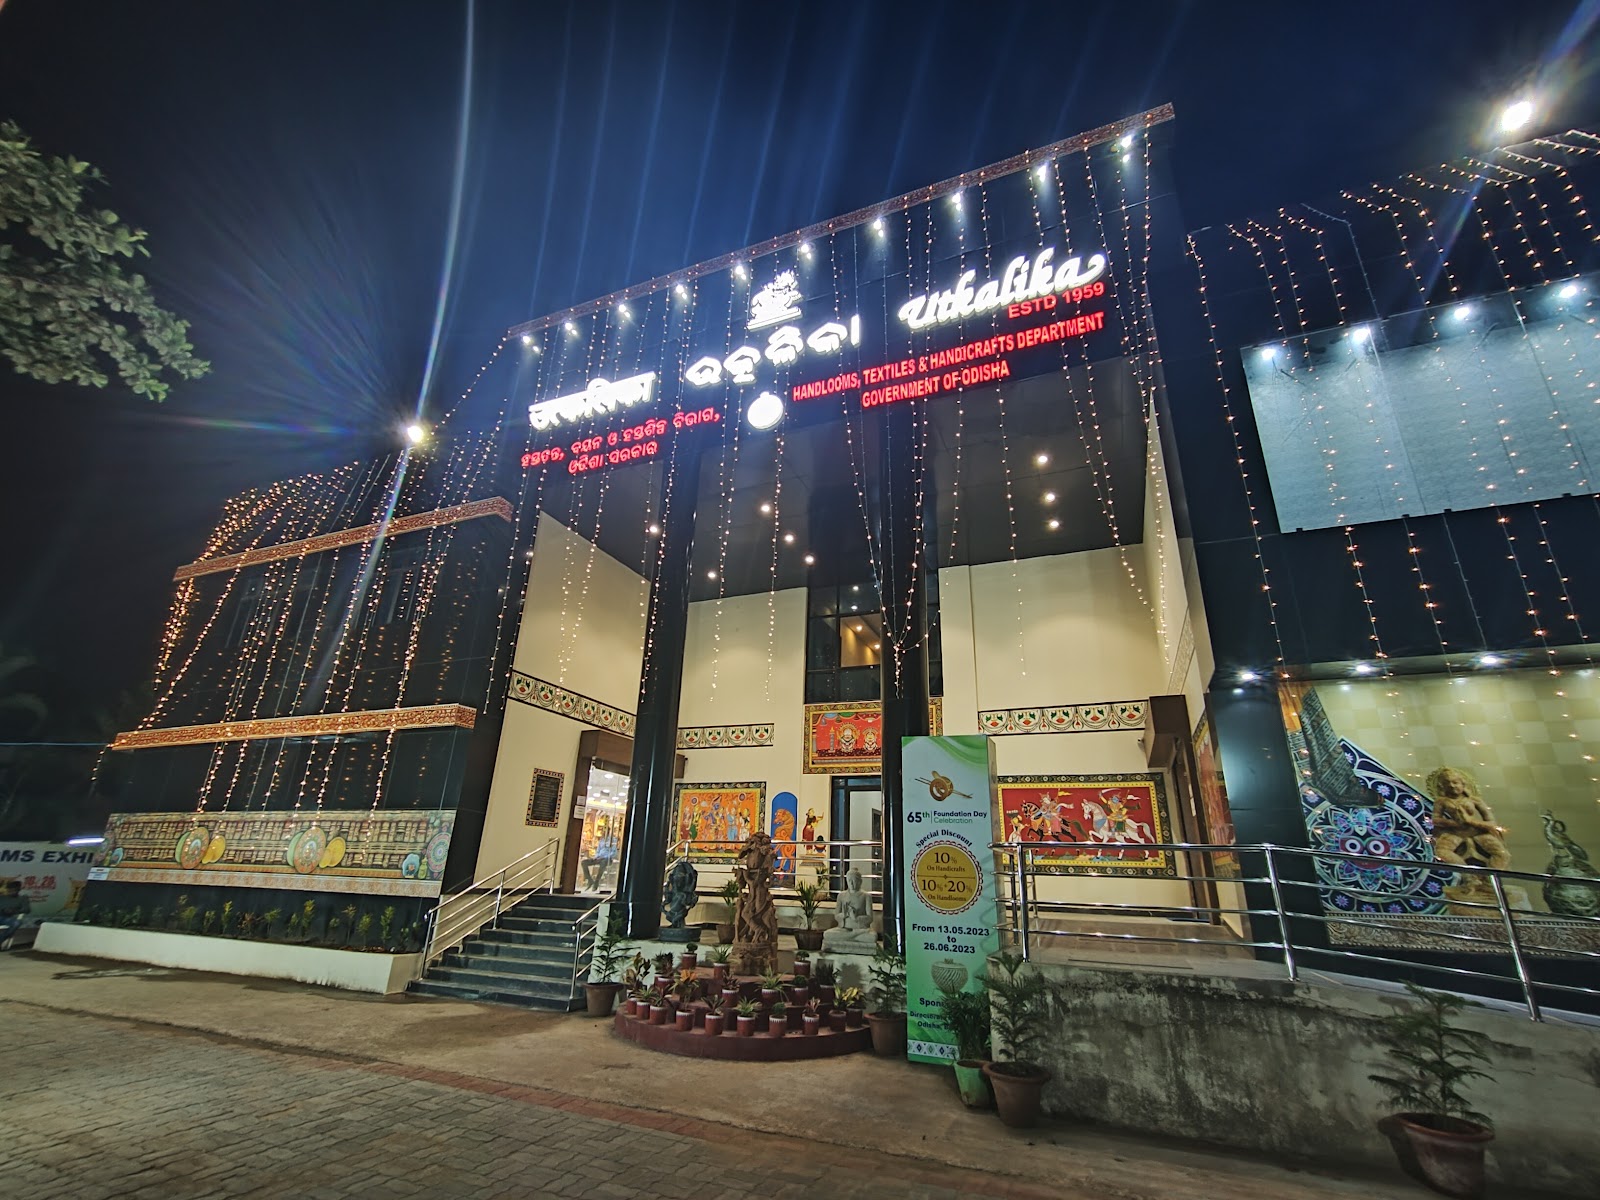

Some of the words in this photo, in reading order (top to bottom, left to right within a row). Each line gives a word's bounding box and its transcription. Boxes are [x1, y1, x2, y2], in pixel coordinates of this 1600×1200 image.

[898, 247, 1106, 329] Utkalika
[1008, 296, 1057, 319] ESTD
[1061, 282, 1105, 304] 1959
[793, 372, 861, 401] HANDLOOMS,
[862, 359, 916, 385] TEXTILES
[918, 356, 928, 373] &
[930, 335, 1014, 369] HANDICRAFTS
[1016, 312, 1105, 349] DEPARTMENT
[862, 376, 940, 407] GOVERNMENT
[943, 370, 960, 390] OF
[963, 360, 1010, 385] ODISHA
[916, 830, 939, 848] Special
[941, 829, 973, 847] Discount
[0, 850, 35, 862] MS
[934, 852, 958, 864] 10%
[937, 894, 966, 902] Handlooms
[912, 924, 935, 933] From
[938, 925, 990, 936] 13.05.2023
[947, 935, 957, 943] to
[924, 942, 976, 954] 26.06.2023
